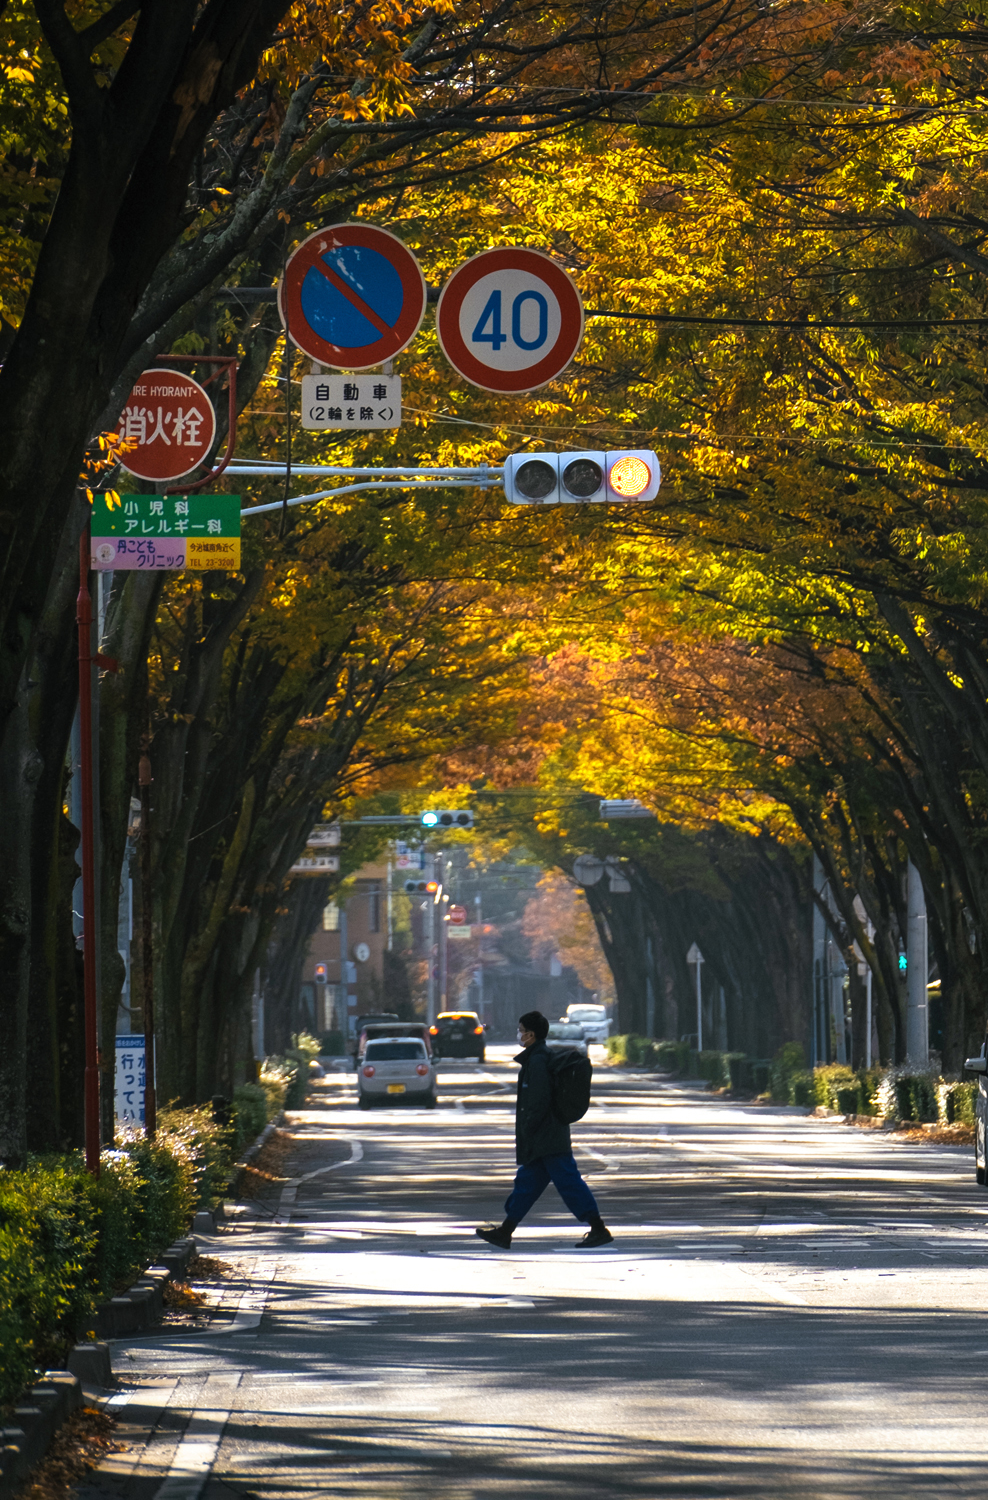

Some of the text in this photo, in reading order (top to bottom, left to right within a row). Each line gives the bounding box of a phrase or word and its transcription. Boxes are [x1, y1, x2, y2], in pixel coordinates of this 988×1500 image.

[471, 289, 549, 351] 40
[133, 385, 193, 397] IRE HYDRANT
[315, 383, 387, 401] 自動車
[309, 406, 394, 421] (2輪を除く)
[117, 405, 204, 447] 消火栓
[124, 501, 189, 516] 小児科
[124, 519, 222, 534] アレルギー科
[117, 539, 156, 554] 丹こども
[137, 554, 185, 568] クリニック
[190, 558, 202, 567] TEL
